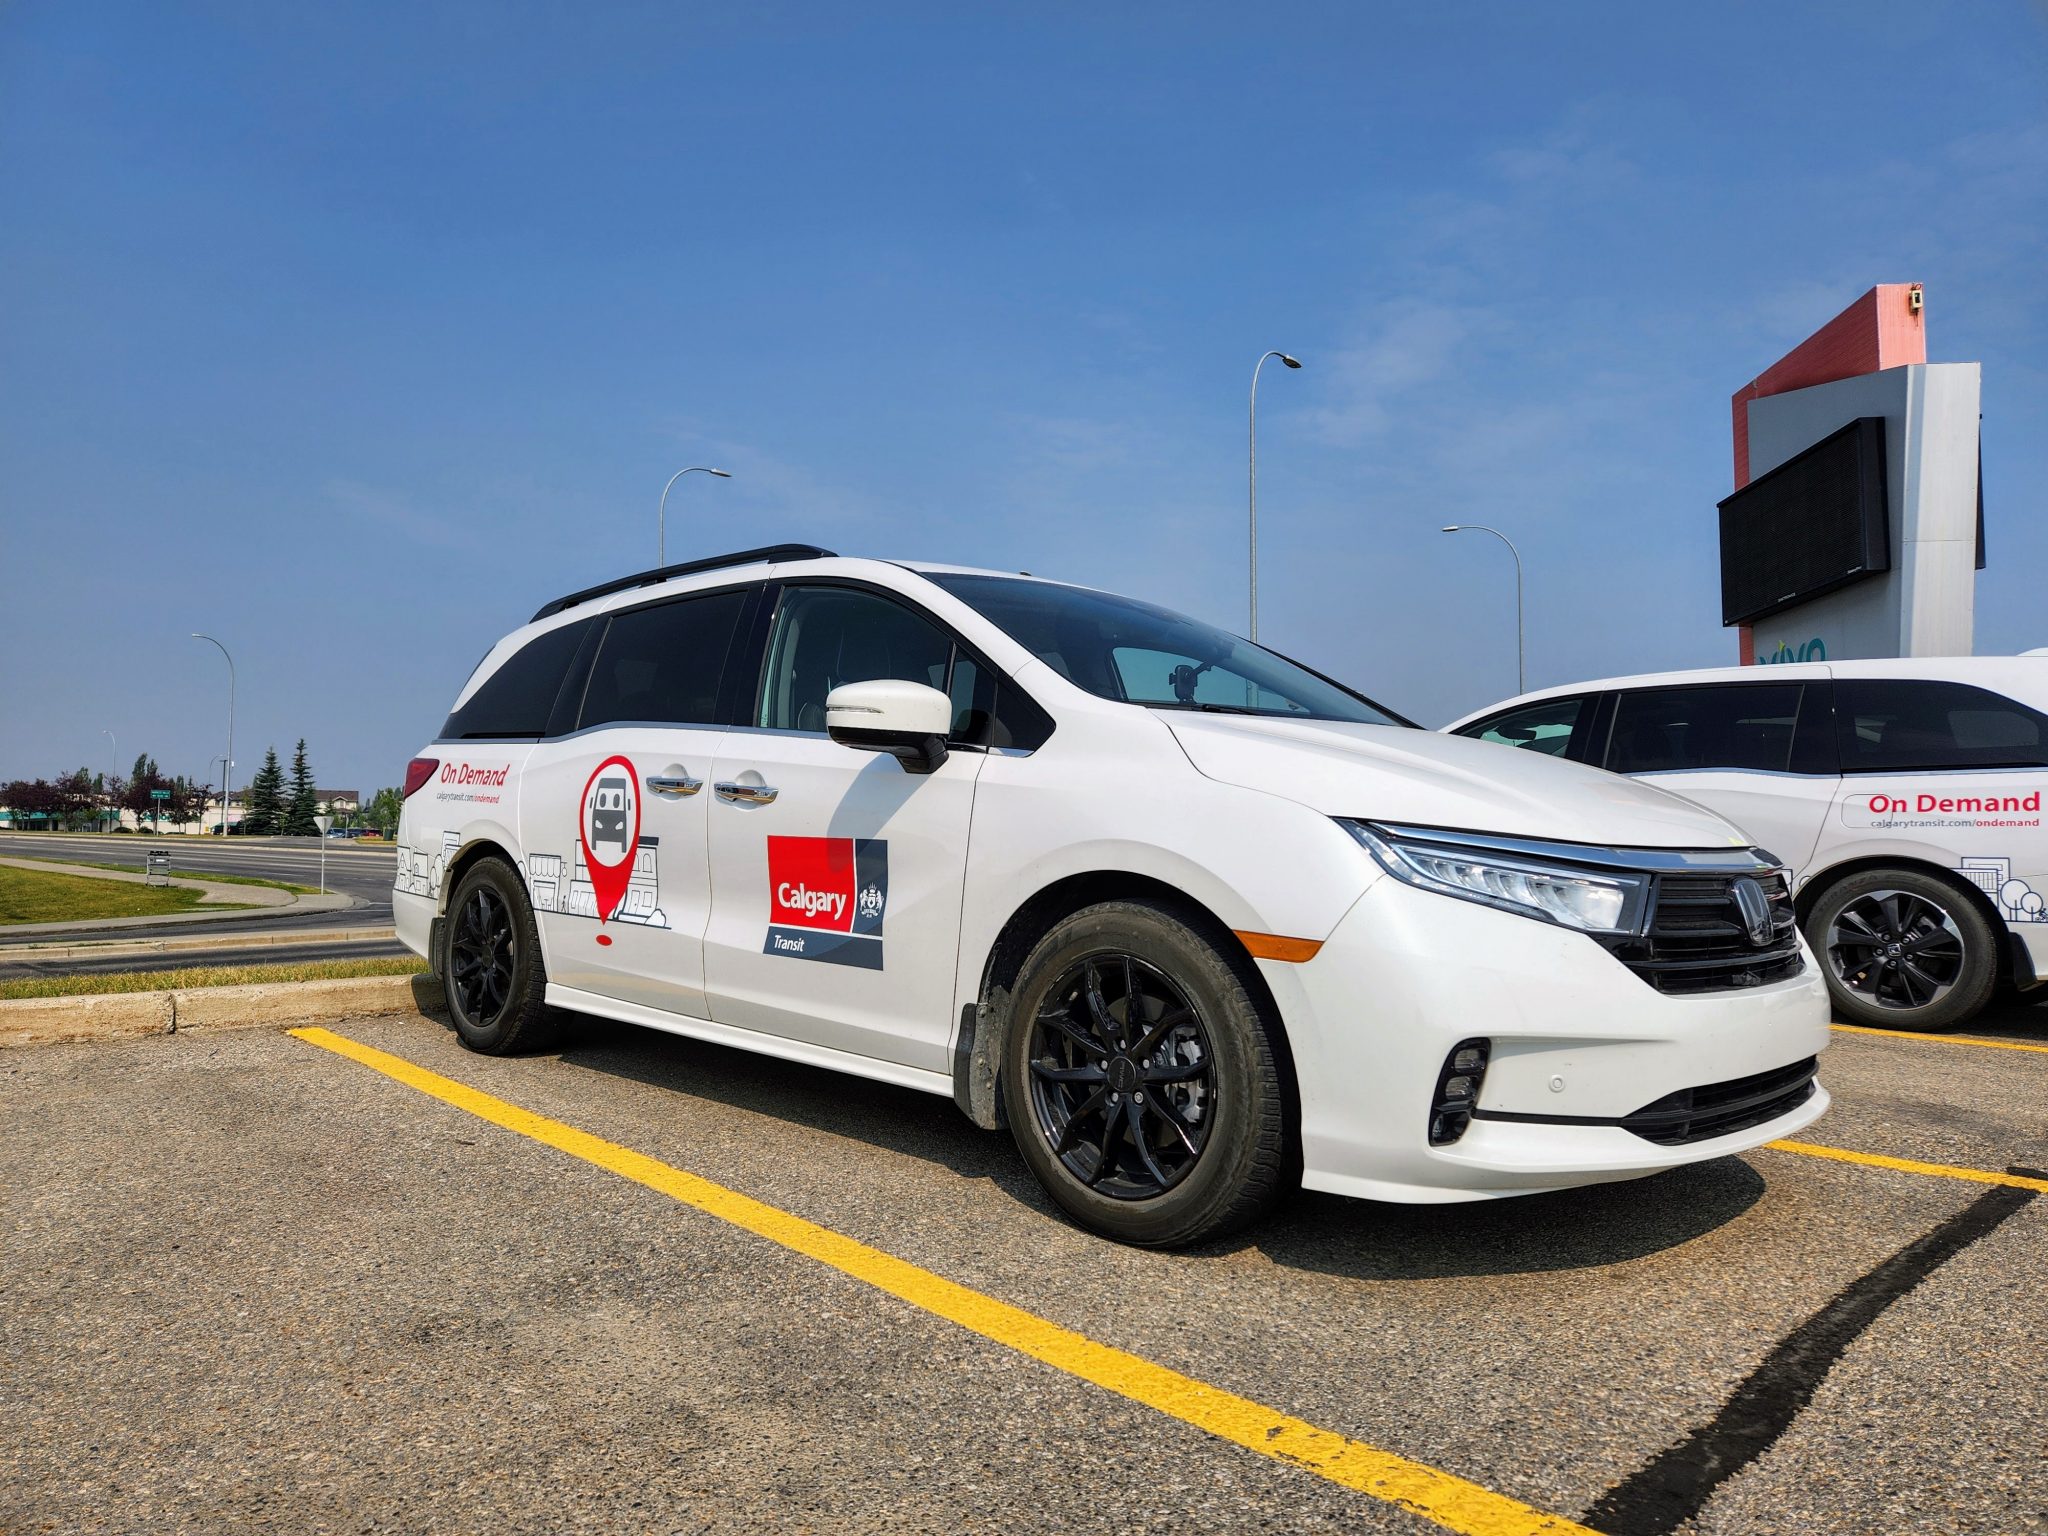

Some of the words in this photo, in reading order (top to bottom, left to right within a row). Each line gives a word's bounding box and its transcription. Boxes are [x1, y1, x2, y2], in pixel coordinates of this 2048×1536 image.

[441, 763, 457, 783] On
[458, 764, 510, 786] Demand
[1869, 795, 1907, 813] On
[1917, 791, 2040, 813] Demand
[1871, 818, 2040, 828] calgarytransit.com/ondemand
[778, 882, 847, 920] Calgary
[774, 935, 805, 952] Transit
